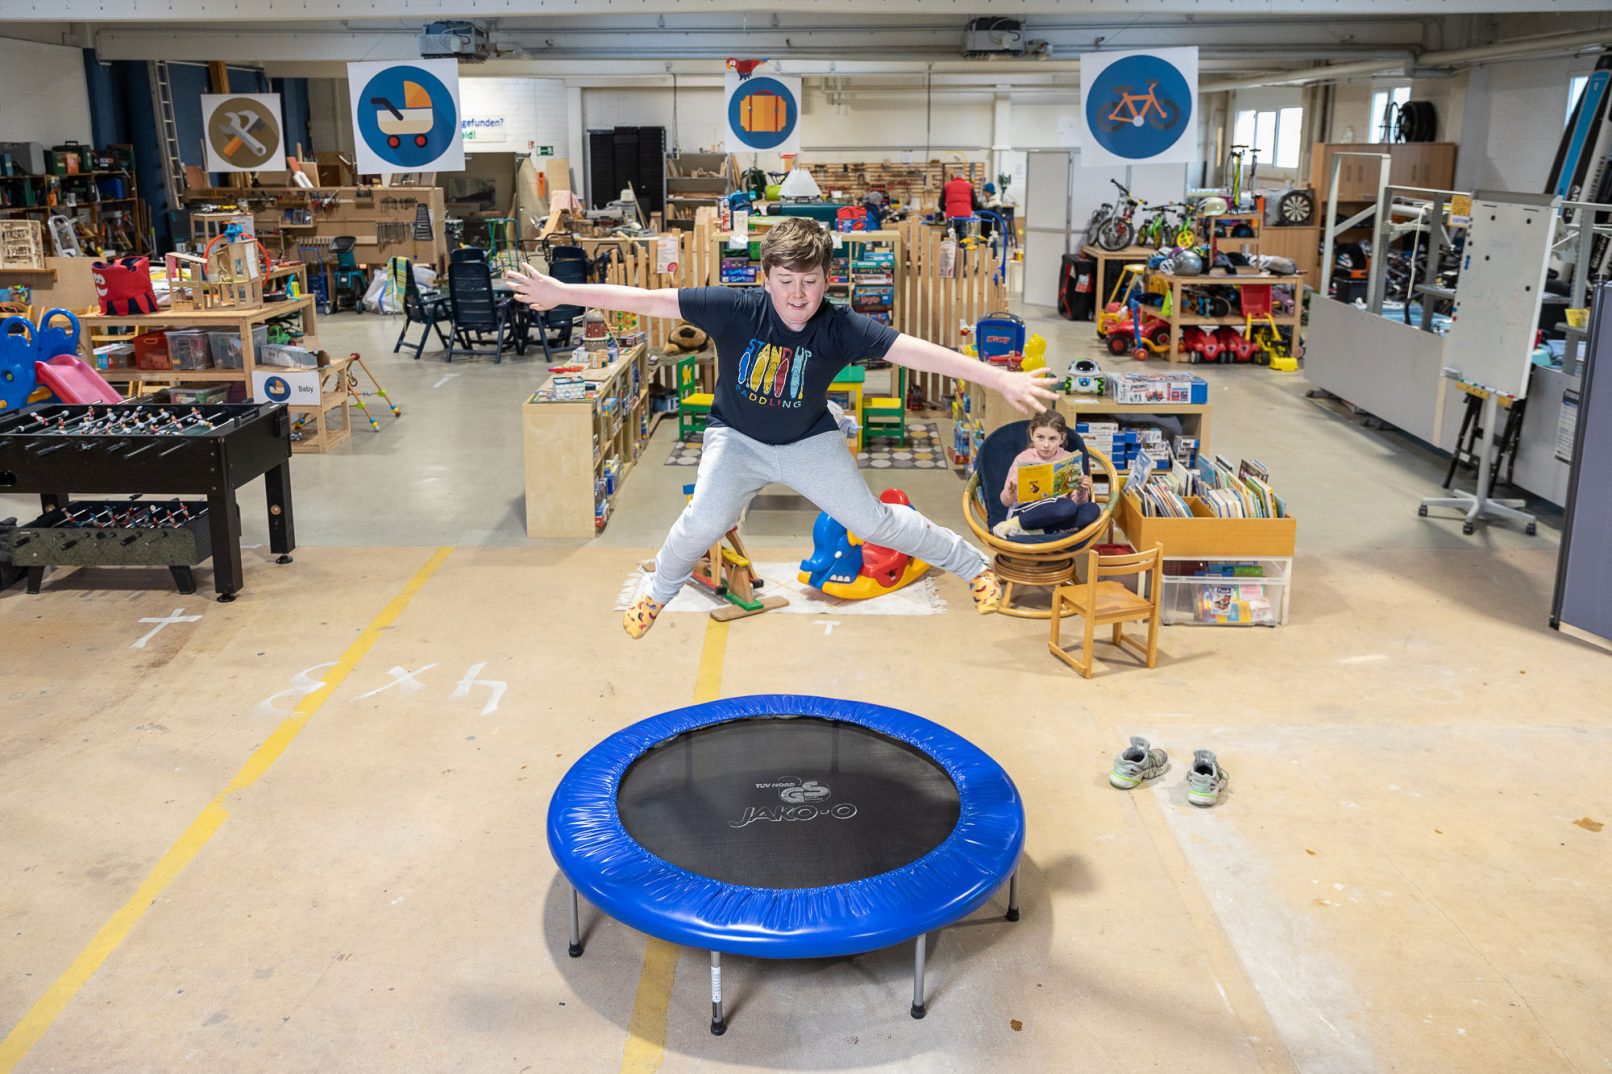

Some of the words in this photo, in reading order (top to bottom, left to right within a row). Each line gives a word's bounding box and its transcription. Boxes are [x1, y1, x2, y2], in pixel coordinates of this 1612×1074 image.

[298, 385, 314, 393] Baby
[735, 384, 802, 409] PADDLING
[780, 781, 829, 803] GS
